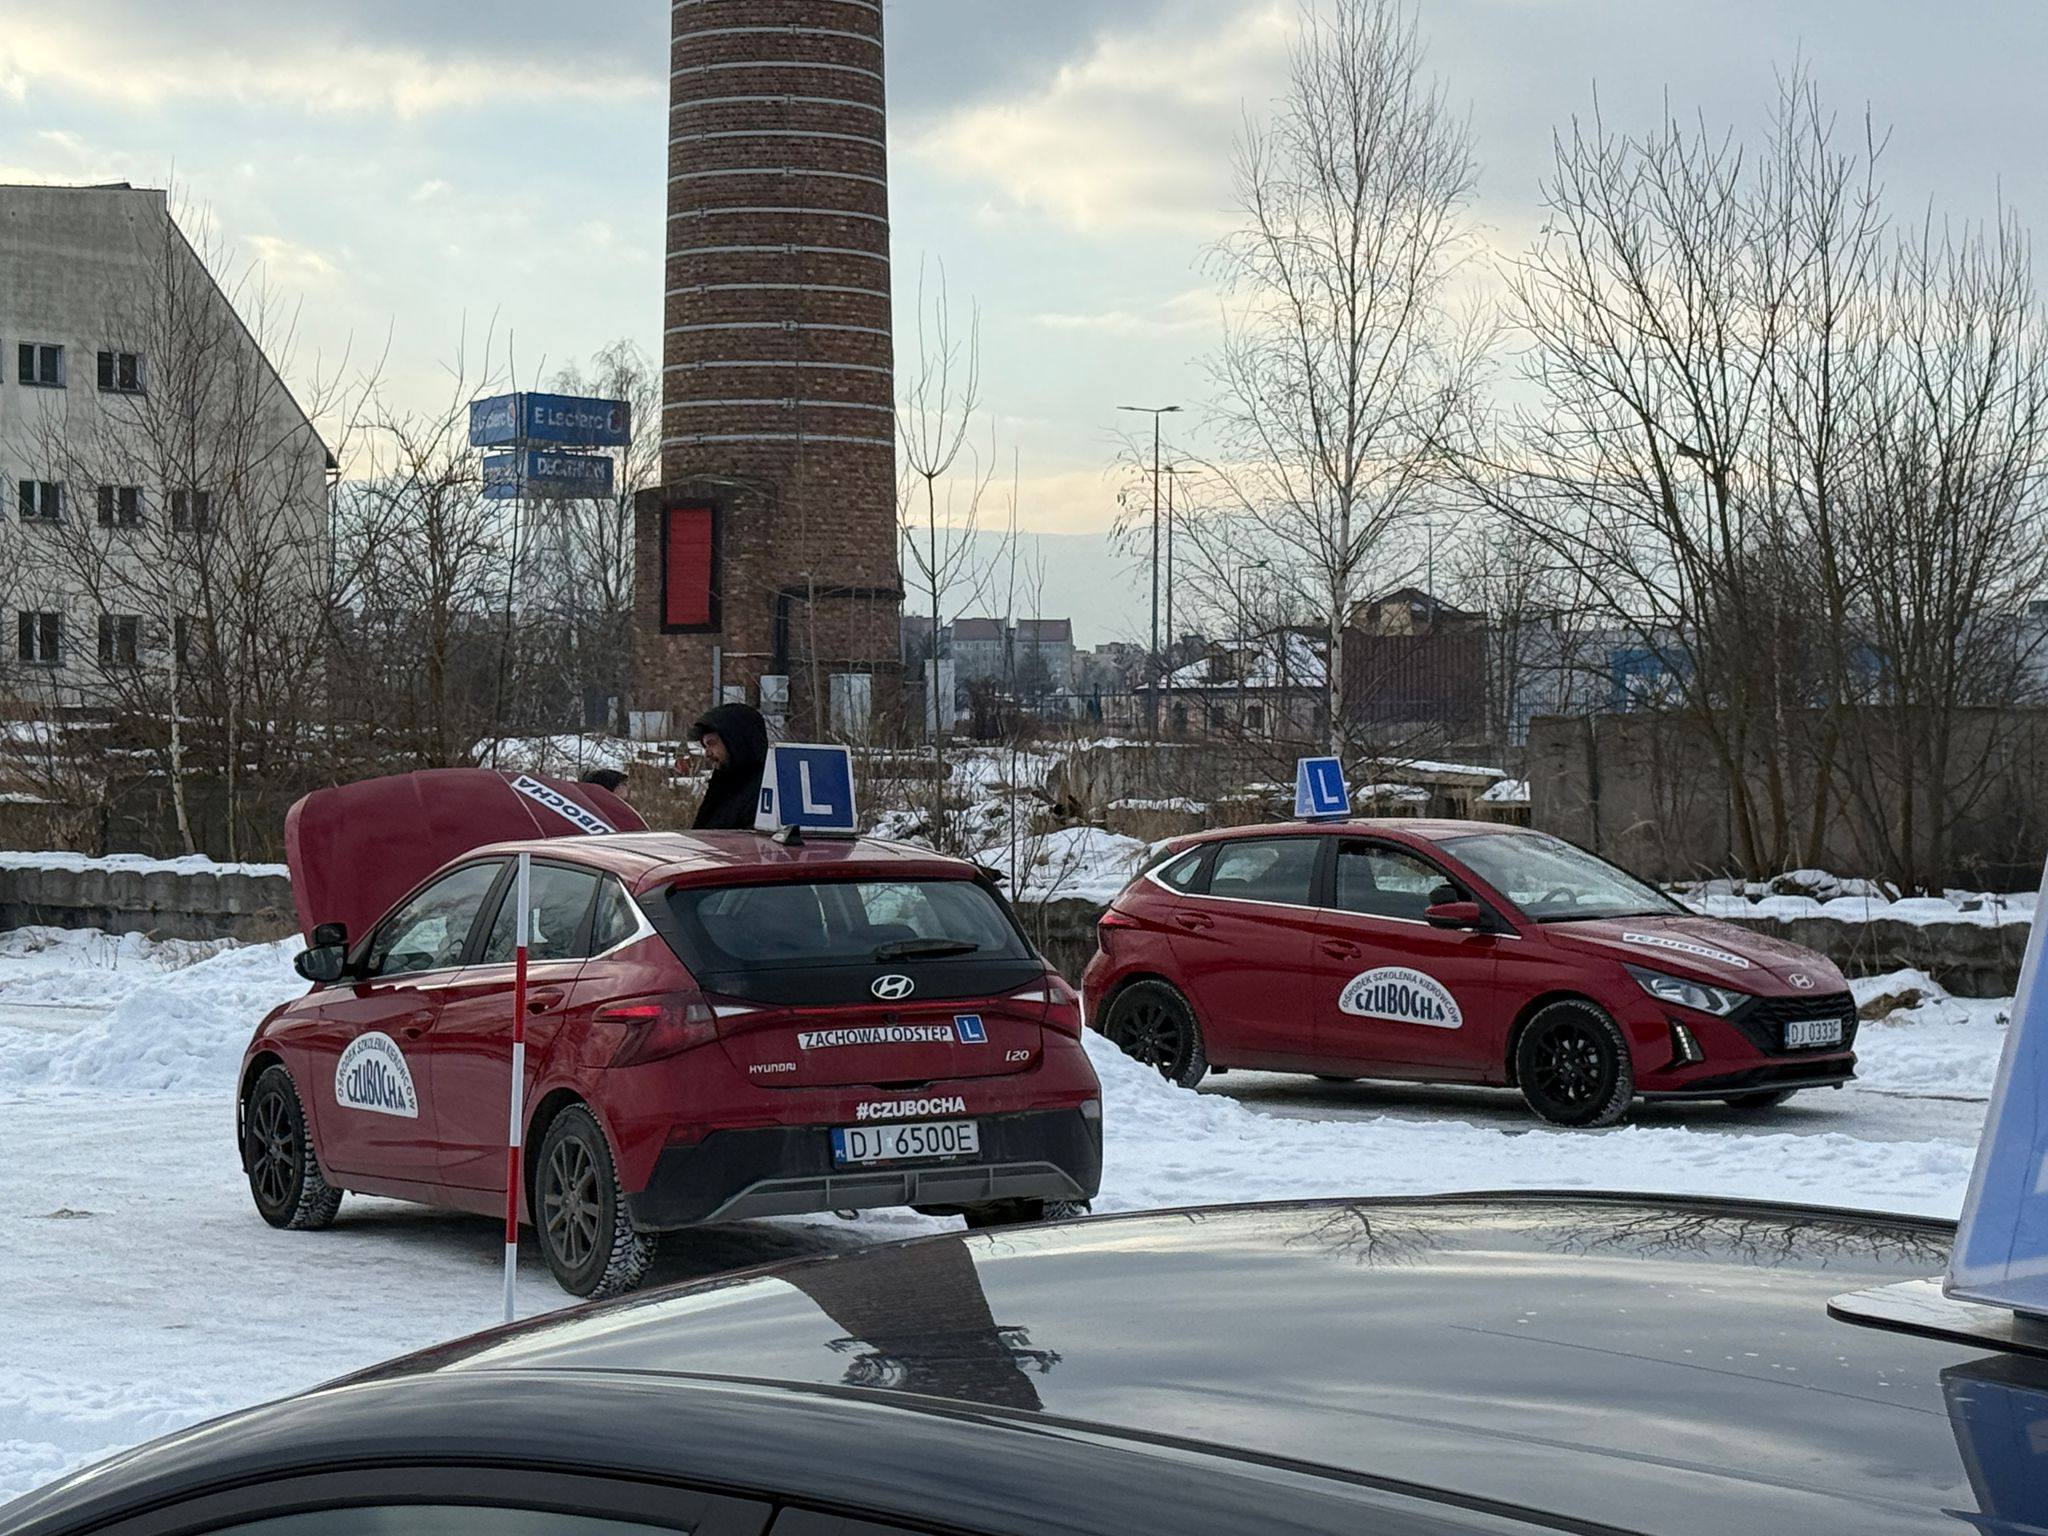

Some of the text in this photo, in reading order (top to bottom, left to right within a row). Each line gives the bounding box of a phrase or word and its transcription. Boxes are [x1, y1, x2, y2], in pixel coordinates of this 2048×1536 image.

[799, 760, 833, 815] L
[1317, 769, 1339, 804] L
[1355, 983, 1445, 1021] CZUBOCHA
[805, 1027, 888, 1048] ZACHOWAJ
[963, 1020, 980, 1038] L
[346, 1058, 407, 1110] CZUBOCHA
[749, 1062, 797, 1073] HYUNDAI
[856, 1096, 966, 1120] #CZUBOCHA
[851, 1124, 973, 1158] DJ 6500E
